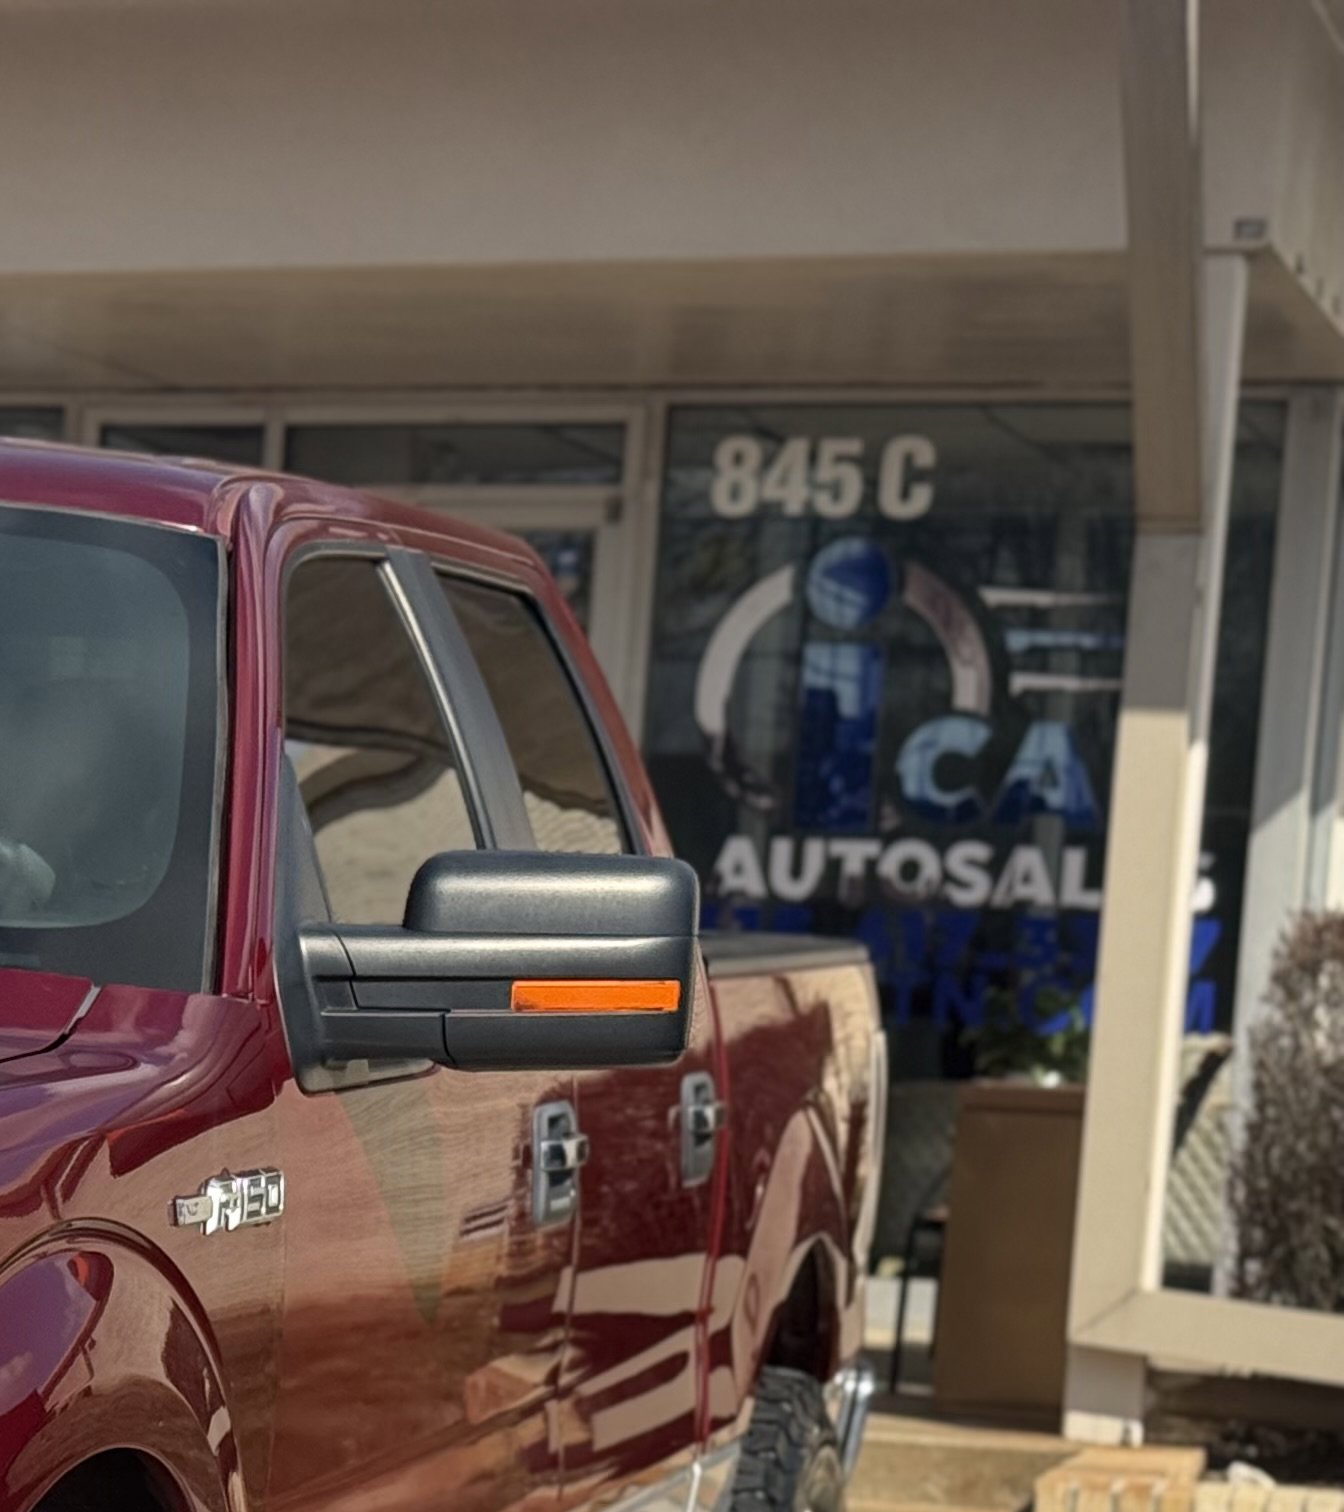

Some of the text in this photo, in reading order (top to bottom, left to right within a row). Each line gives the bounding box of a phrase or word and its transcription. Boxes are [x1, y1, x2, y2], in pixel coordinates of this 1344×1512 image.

[713, 434, 937, 521] 845 C
[715, 838, 1216, 912] AUTOSAL
